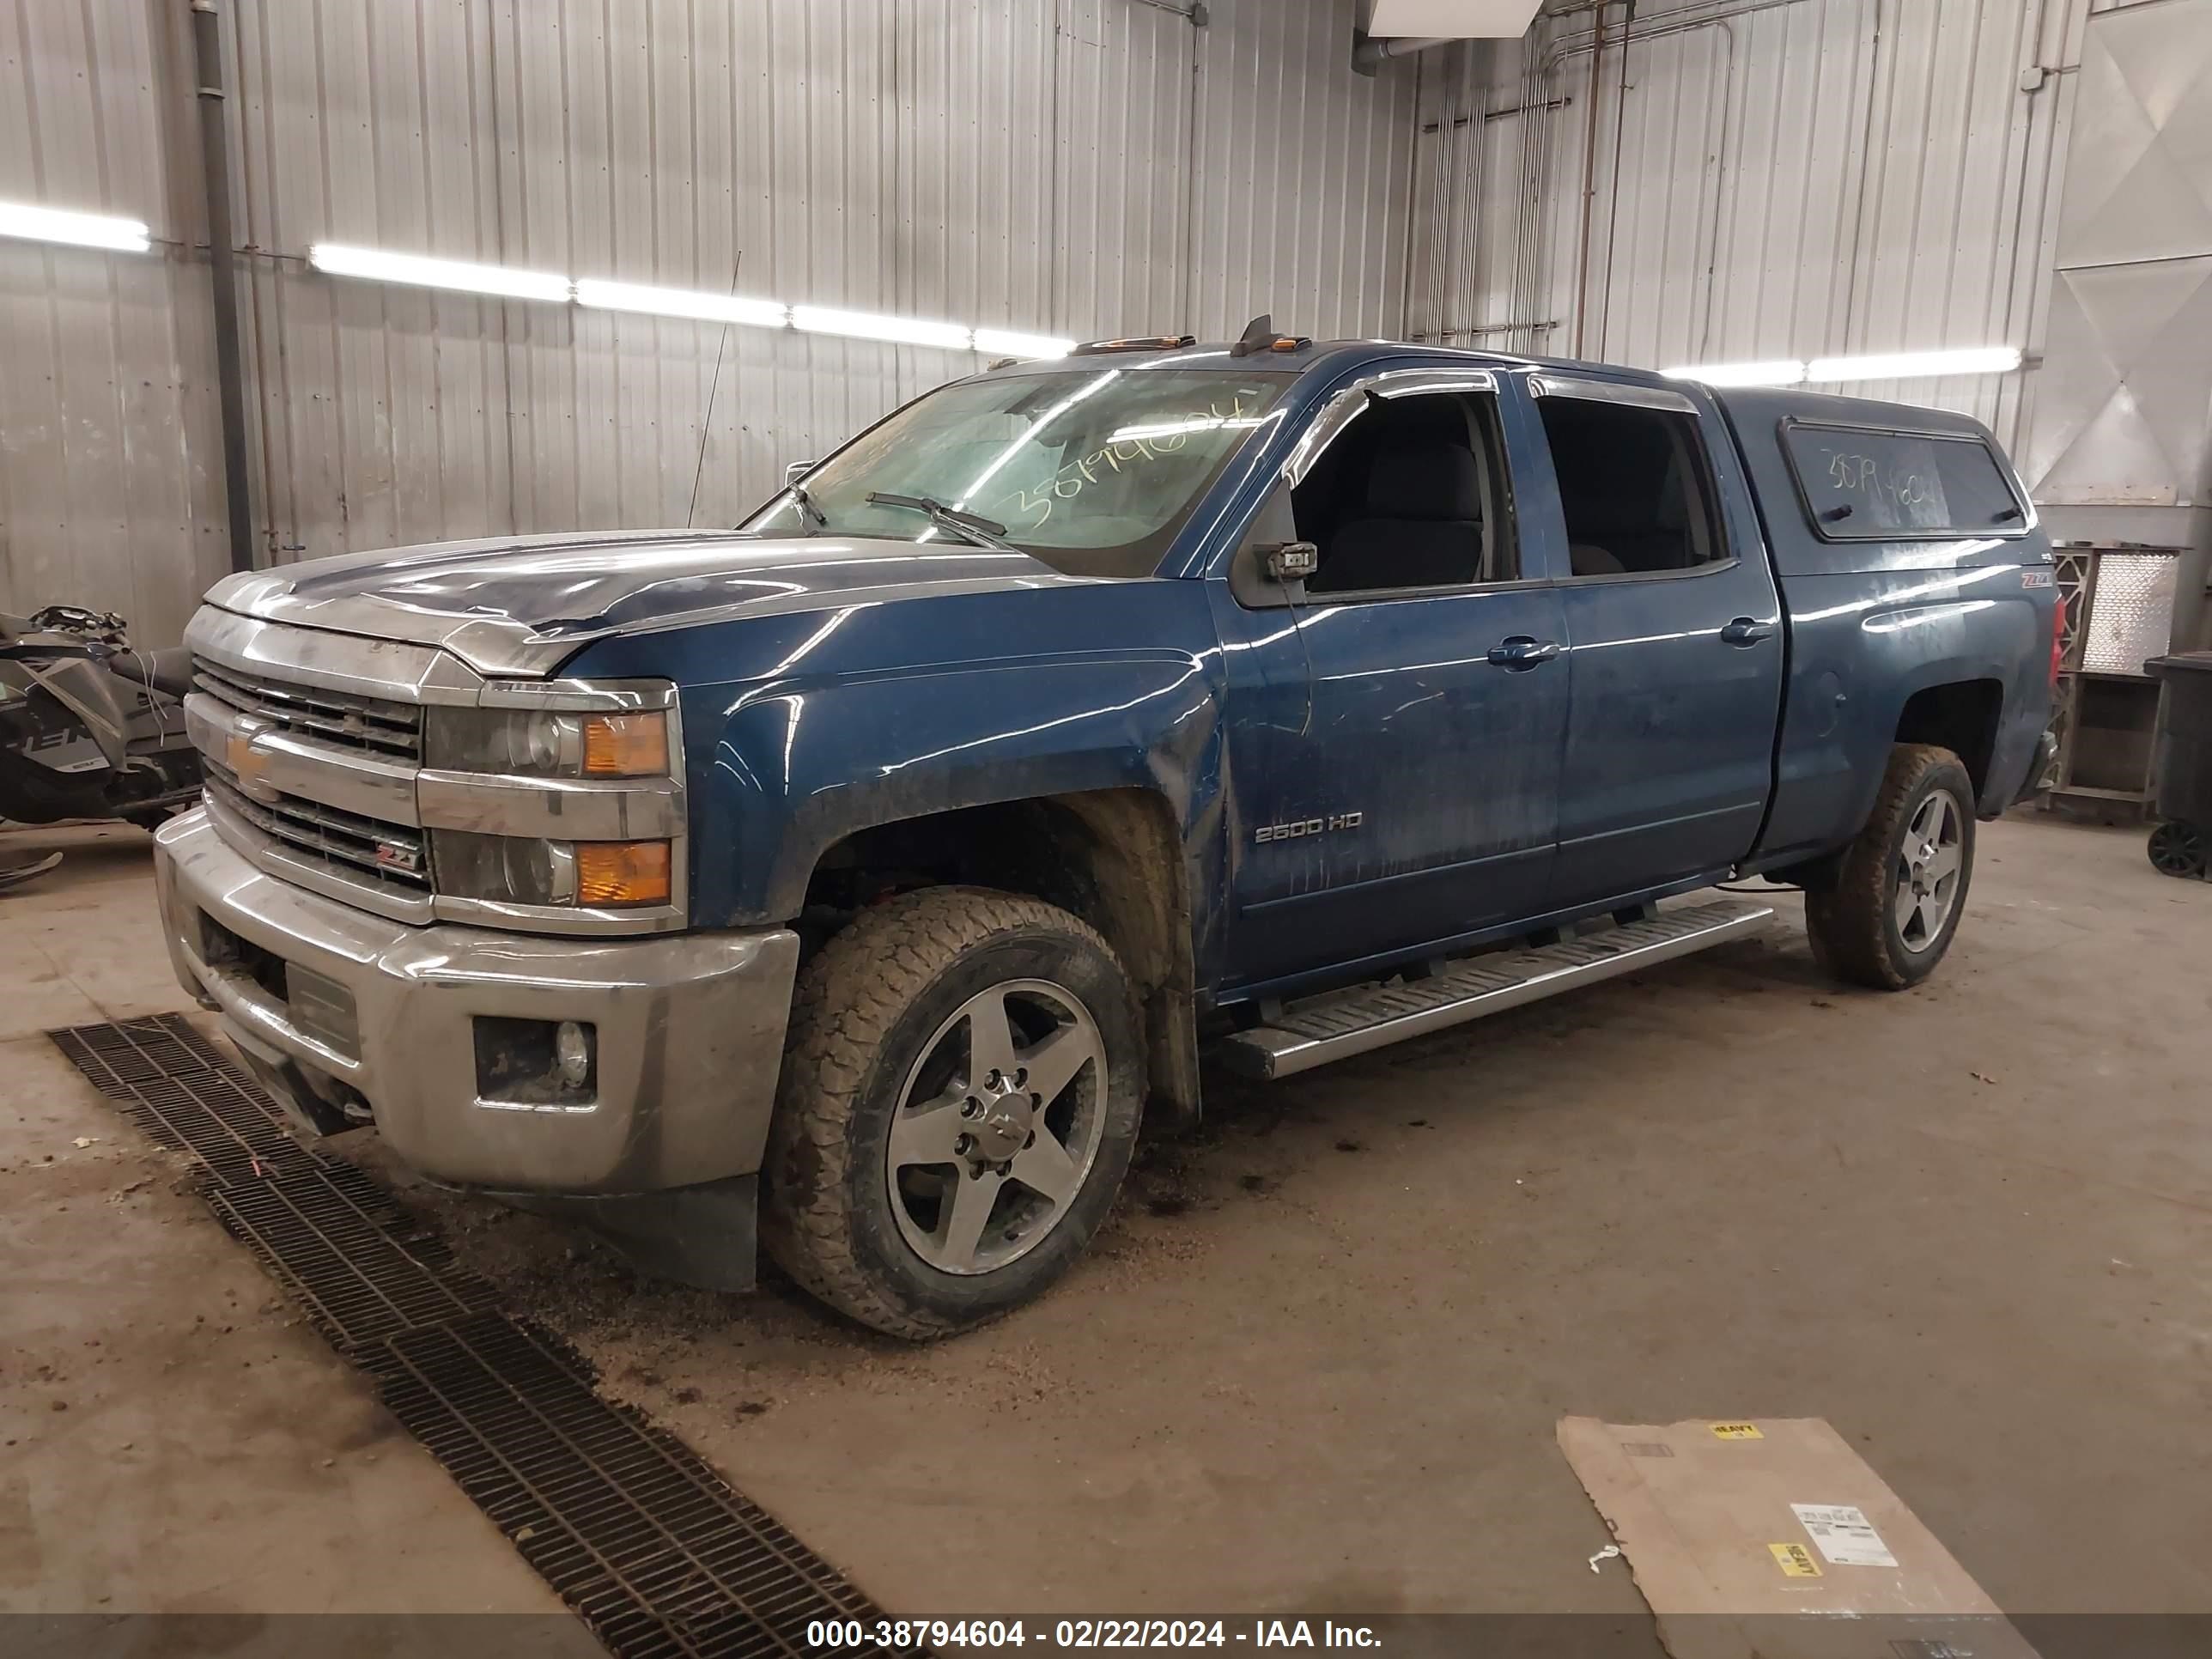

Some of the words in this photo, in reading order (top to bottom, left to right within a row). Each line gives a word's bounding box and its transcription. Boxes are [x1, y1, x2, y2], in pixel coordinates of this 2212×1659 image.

[992, 397, 1243, 530] 38794604
[2021, 572, 2053, 589] Z71
[1255, 818, 1323, 844] 2500
[1328, 811, 1364, 831] HD
[376, 844, 418, 871] Z71
[1785, 1545, 1818, 1576] HEAVY
